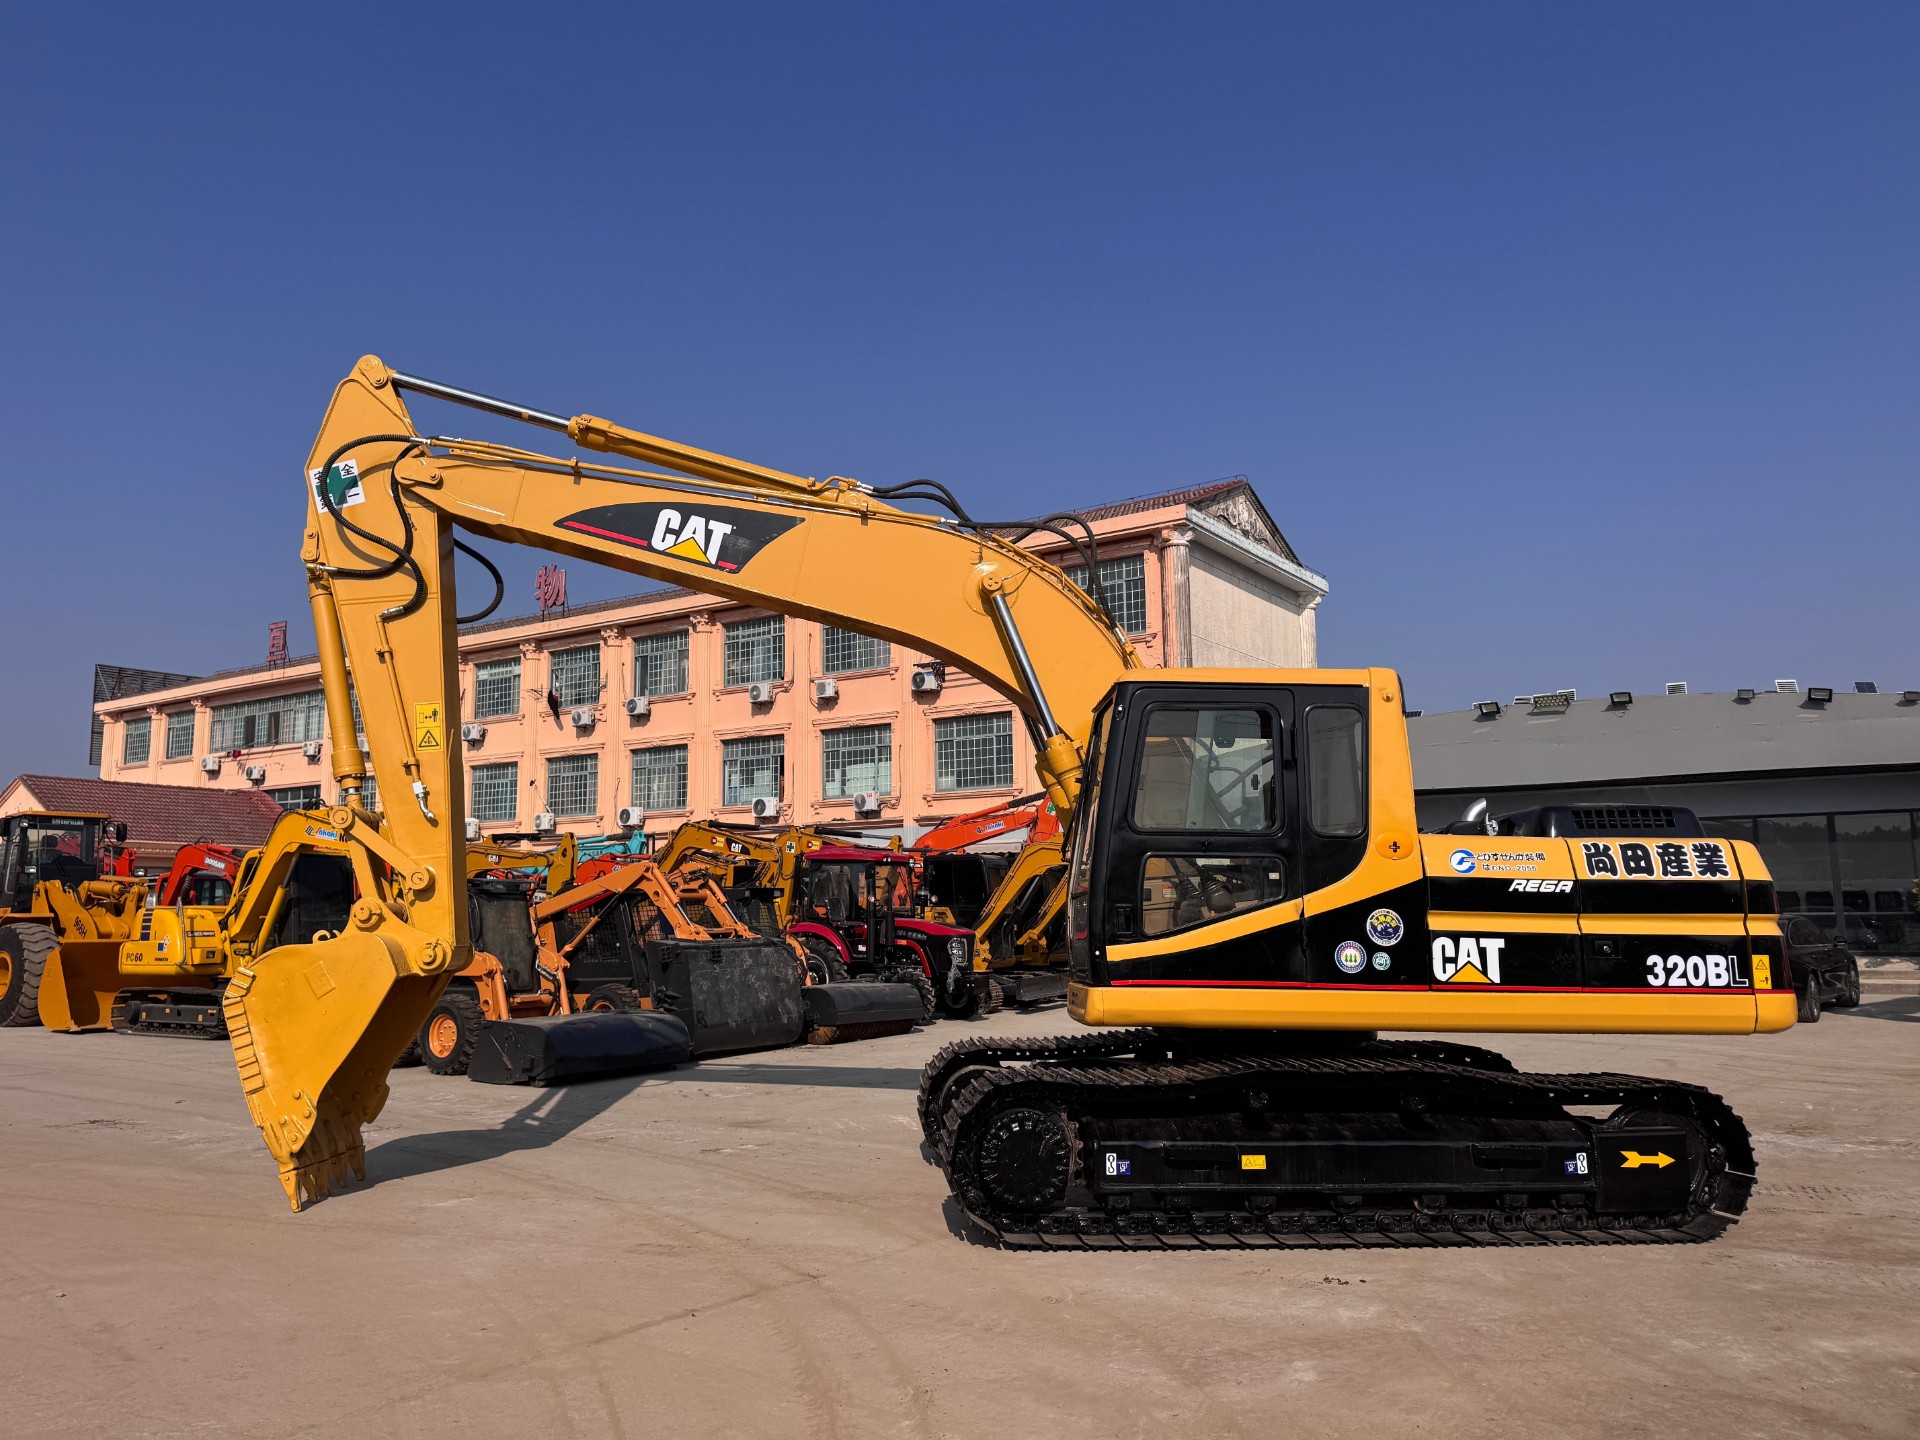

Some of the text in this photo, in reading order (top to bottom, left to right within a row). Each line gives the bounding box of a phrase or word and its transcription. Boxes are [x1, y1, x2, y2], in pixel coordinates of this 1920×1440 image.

[651, 508, 733, 565] CAT
[535, 564, 566, 611] 物
[204, 856, 226, 870] DOOSAN
[731, 843, 742, 853] CAT
[1581, 842, 1731, 877] 尚田産業
[1508, 879, 1574, 893] REGA
[125, 952, 144, 963] PC60
[1432, 937, 1505, 983] CAT
[1646, 954, 1749, 987] 320BL
